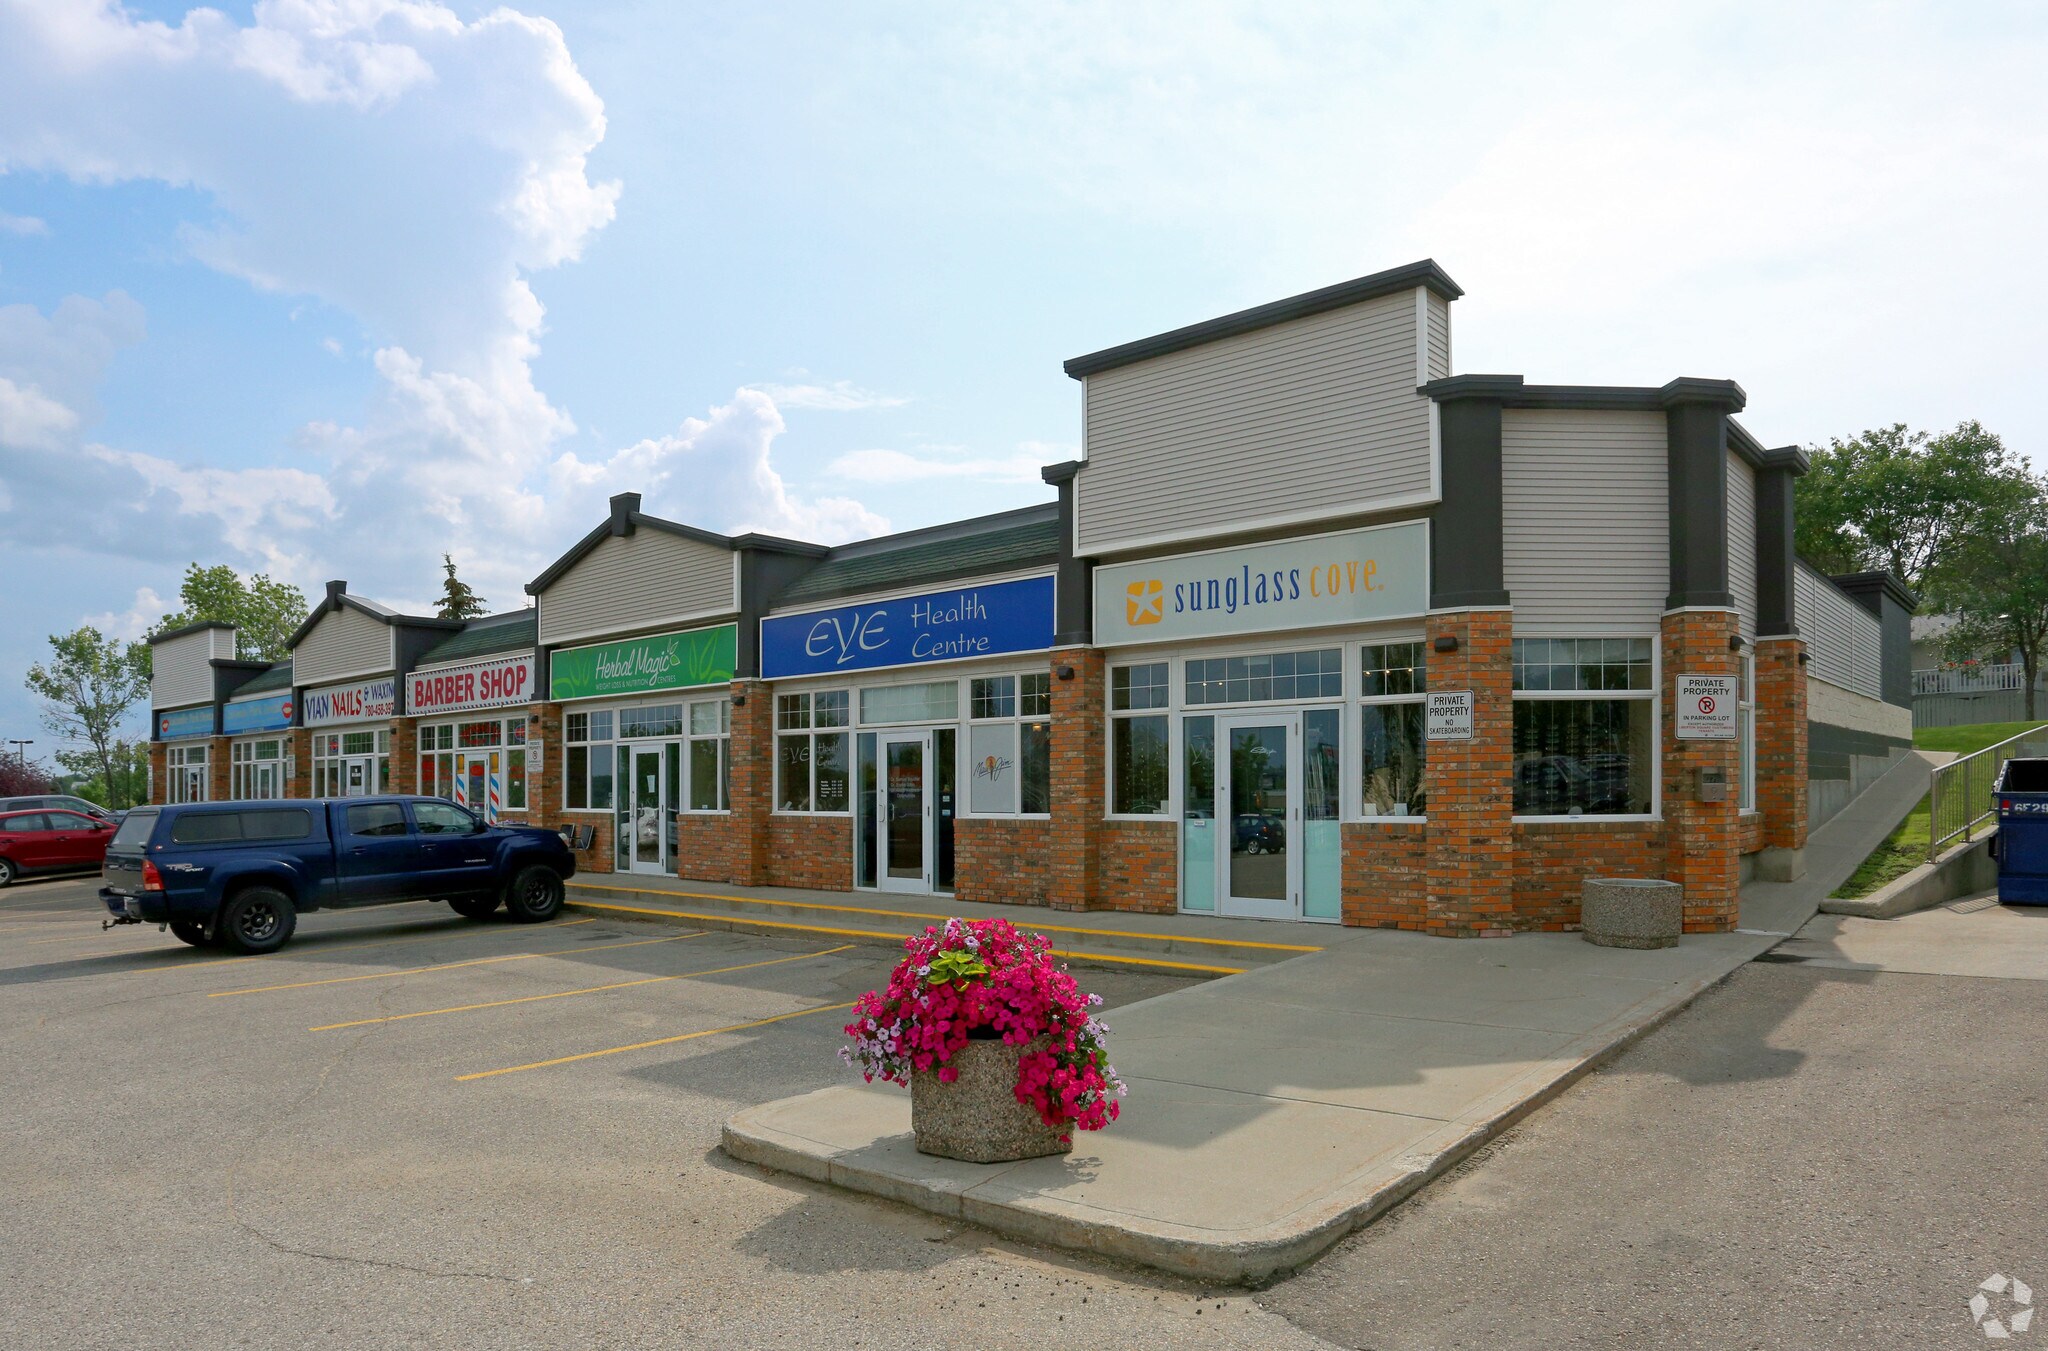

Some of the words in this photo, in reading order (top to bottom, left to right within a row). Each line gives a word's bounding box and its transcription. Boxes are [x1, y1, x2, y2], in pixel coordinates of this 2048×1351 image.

[1174, 565, 1300, 614] sunglass
[911, 593, 987, 628] Health
[912, 633, 991, 658] Centre
[595, 648, 636, 680] Herbal
[634, 646, 670, 686] Magic
[415, 673, 475, 707] BARBER
[480, 664, 527, 700] SHOP
[596, 683, 611, 691] WEIGHT
[626, 678, 649, 687] NUTRITION
[657, 675, 677, 684] CENTRES
[1689, 679, 1724, 687] PRIVATE
[305, 694, 329, 720] VIAN
[331, 689, 362, 718] NAILS
[364, 686, 369, 702] &
[1434, 696, 1465, 705] PRIVATE
[1429, 706, 1470, 717] PROPERTY
[1429, 726, 1470, 734] SKATEBOARDING
[817, 741, 843, 754] Health
